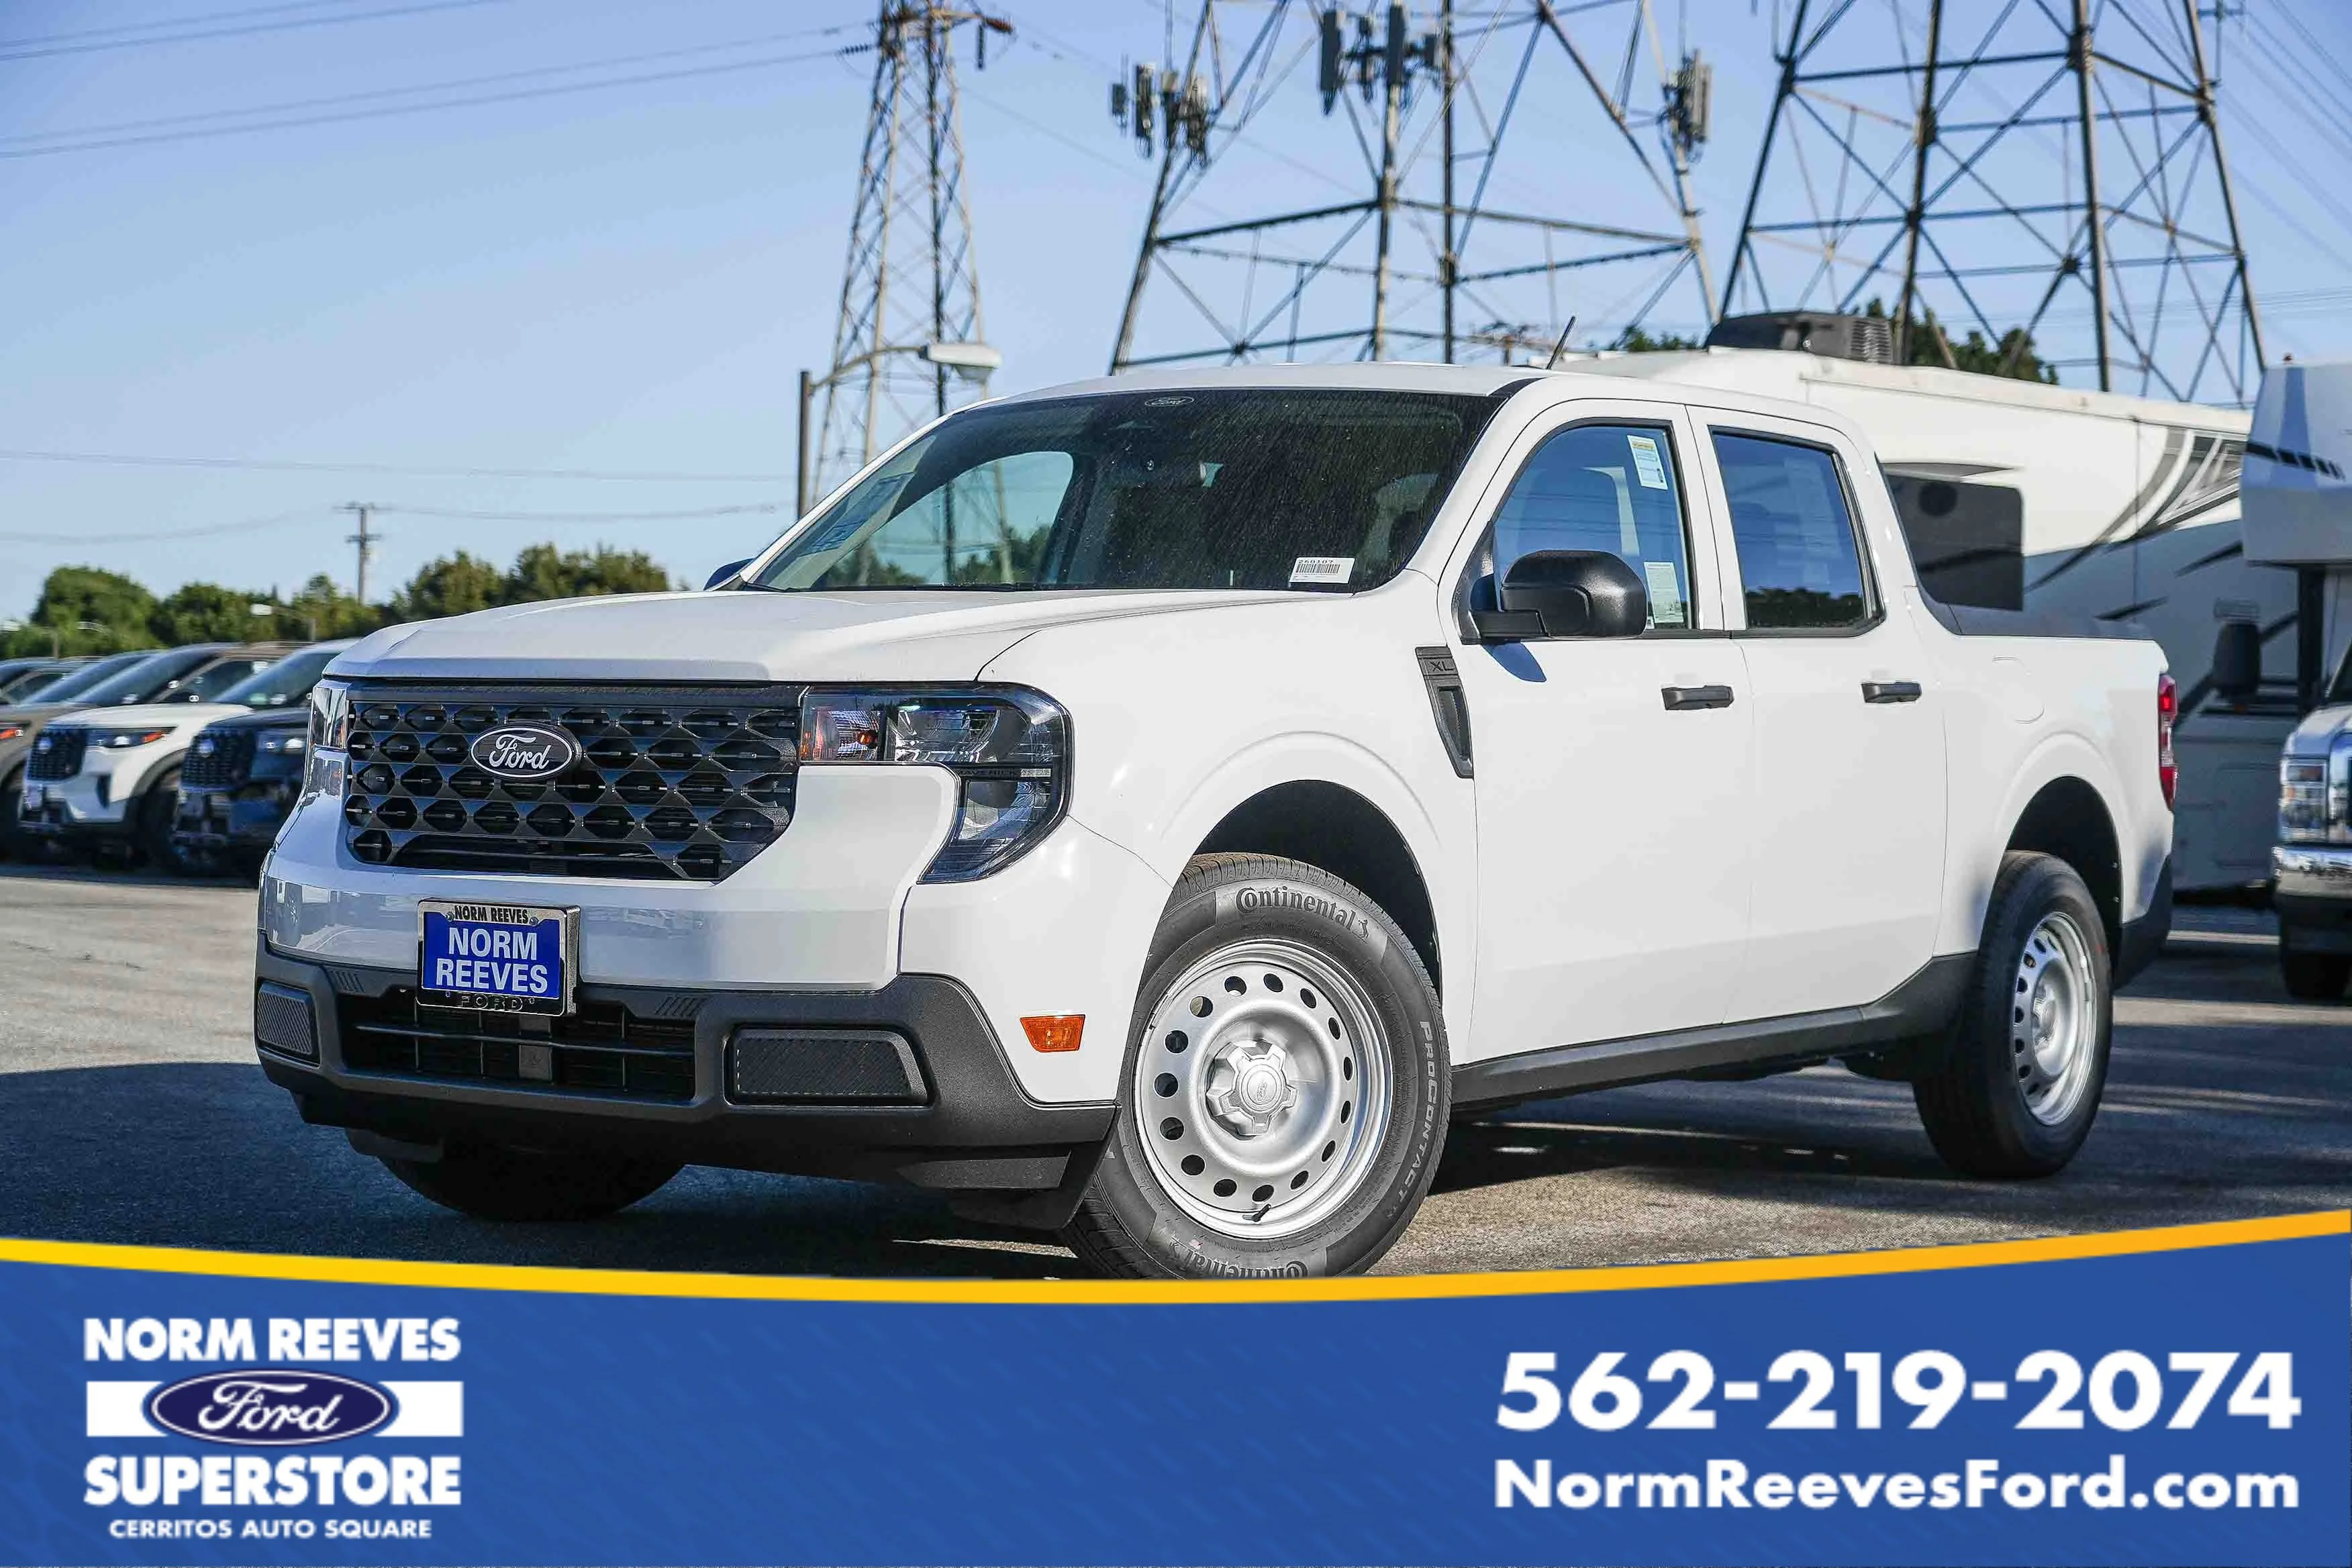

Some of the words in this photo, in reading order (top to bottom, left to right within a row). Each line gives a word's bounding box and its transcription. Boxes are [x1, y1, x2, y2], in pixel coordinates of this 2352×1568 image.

[1429, 661, 1454, 672] XL
[489, 734, 552, 769] Ford
[454, 905, 488, 922] NORM
[491, 908, 529, 924] REEVES
[1235, 885, 1357, 930] Continental
[449, 927, 538, 961] NORM
[436, 958, 548, 993] REEVES
[461, 993, 523, 1012] FORD
